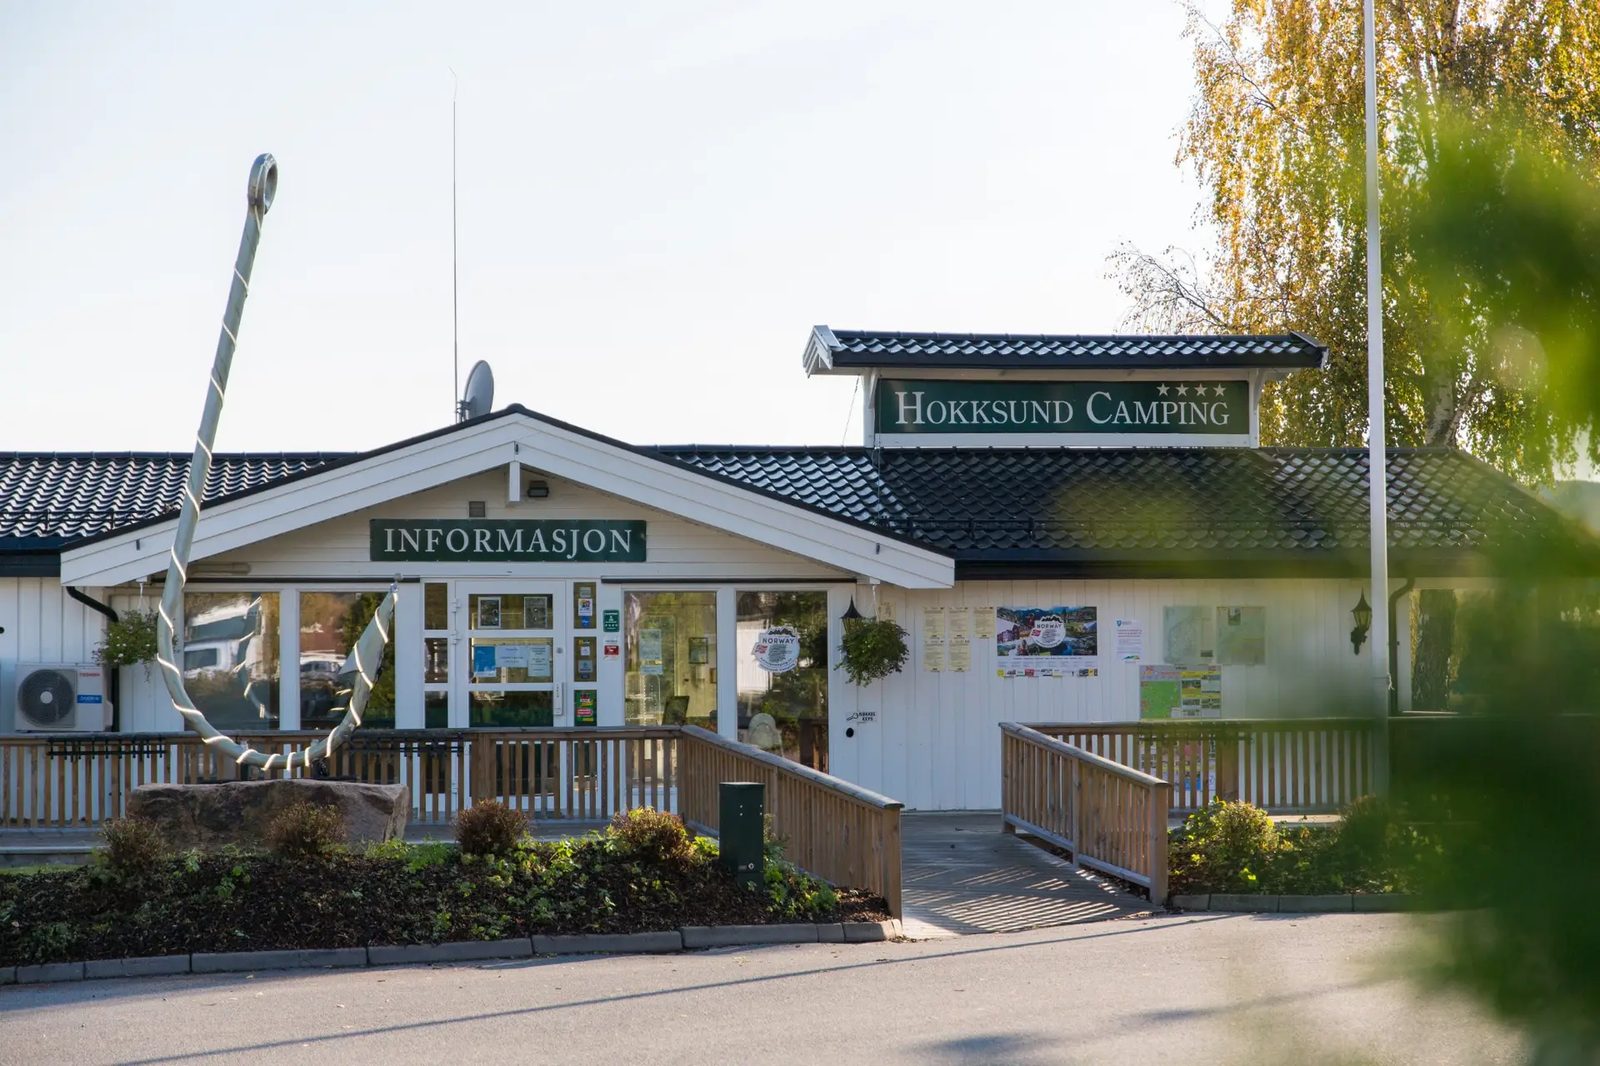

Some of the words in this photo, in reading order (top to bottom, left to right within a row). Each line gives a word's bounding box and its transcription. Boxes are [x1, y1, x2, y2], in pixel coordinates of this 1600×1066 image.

[895, 391, 1074, 425] HOKKSUND
[1086, 391, 1230, 426] CAMPING
[384, 528, 632, 559] INFORMASJON
